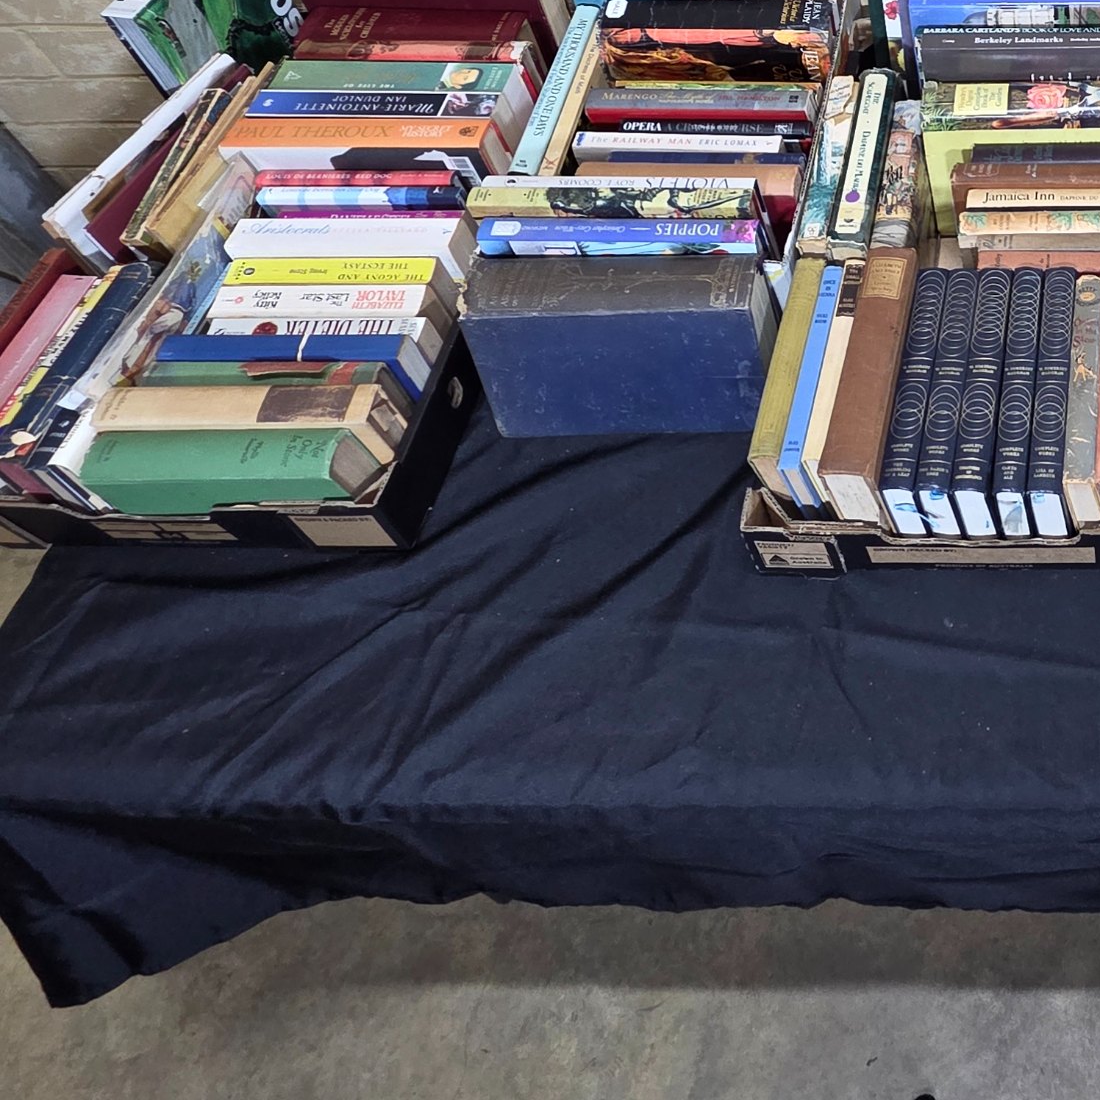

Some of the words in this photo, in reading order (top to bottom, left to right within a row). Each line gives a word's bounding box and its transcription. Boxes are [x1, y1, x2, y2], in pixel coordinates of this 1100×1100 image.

[812, 1, 822, 19] JEAN
[578, 20, 587, 32] MY
[562, 32, 584, 73] THOUSAND
[552, 77, 564, 94] AND
[332, 95, 382, 103] DUNLOP
[385, 95, 407, 103] IAN
[602, 92, 657, 100] MARENGO
[294, 102, 435, 114] MARIE-ANTOINETTE
[544, 96, 555, 115] ONE
[534, 116, 548, 135] DAYS
[623, 122, 662, 131] OPERA
[235, 126, 284, 138] PAUL
[295, 126, 396, 138] THEROUX
[590, 136, 608, 144] The
[982, 191, 1029, 203] Jamaica
[1034, 191, 1055, 201] Inn
[244, 220, 332, 235] Aristocrats
[655, 223, 720, 235] POPPIES
[338, 274, 357, 282] AND
[364, 274, 398, 282] AGONY
[406, 273, 425, 281] THE
[299, 293, 323, 301] Star
[330, 292, 350, 301] Last
[356, 291, 406, 301] TAYLOR
[253, 300, 278, 309] Kitty
[351, 302, 404, 310] ELIZABETH
[286, 321, 354, 335] DIETER
[357, 320, 395, 334] THE
